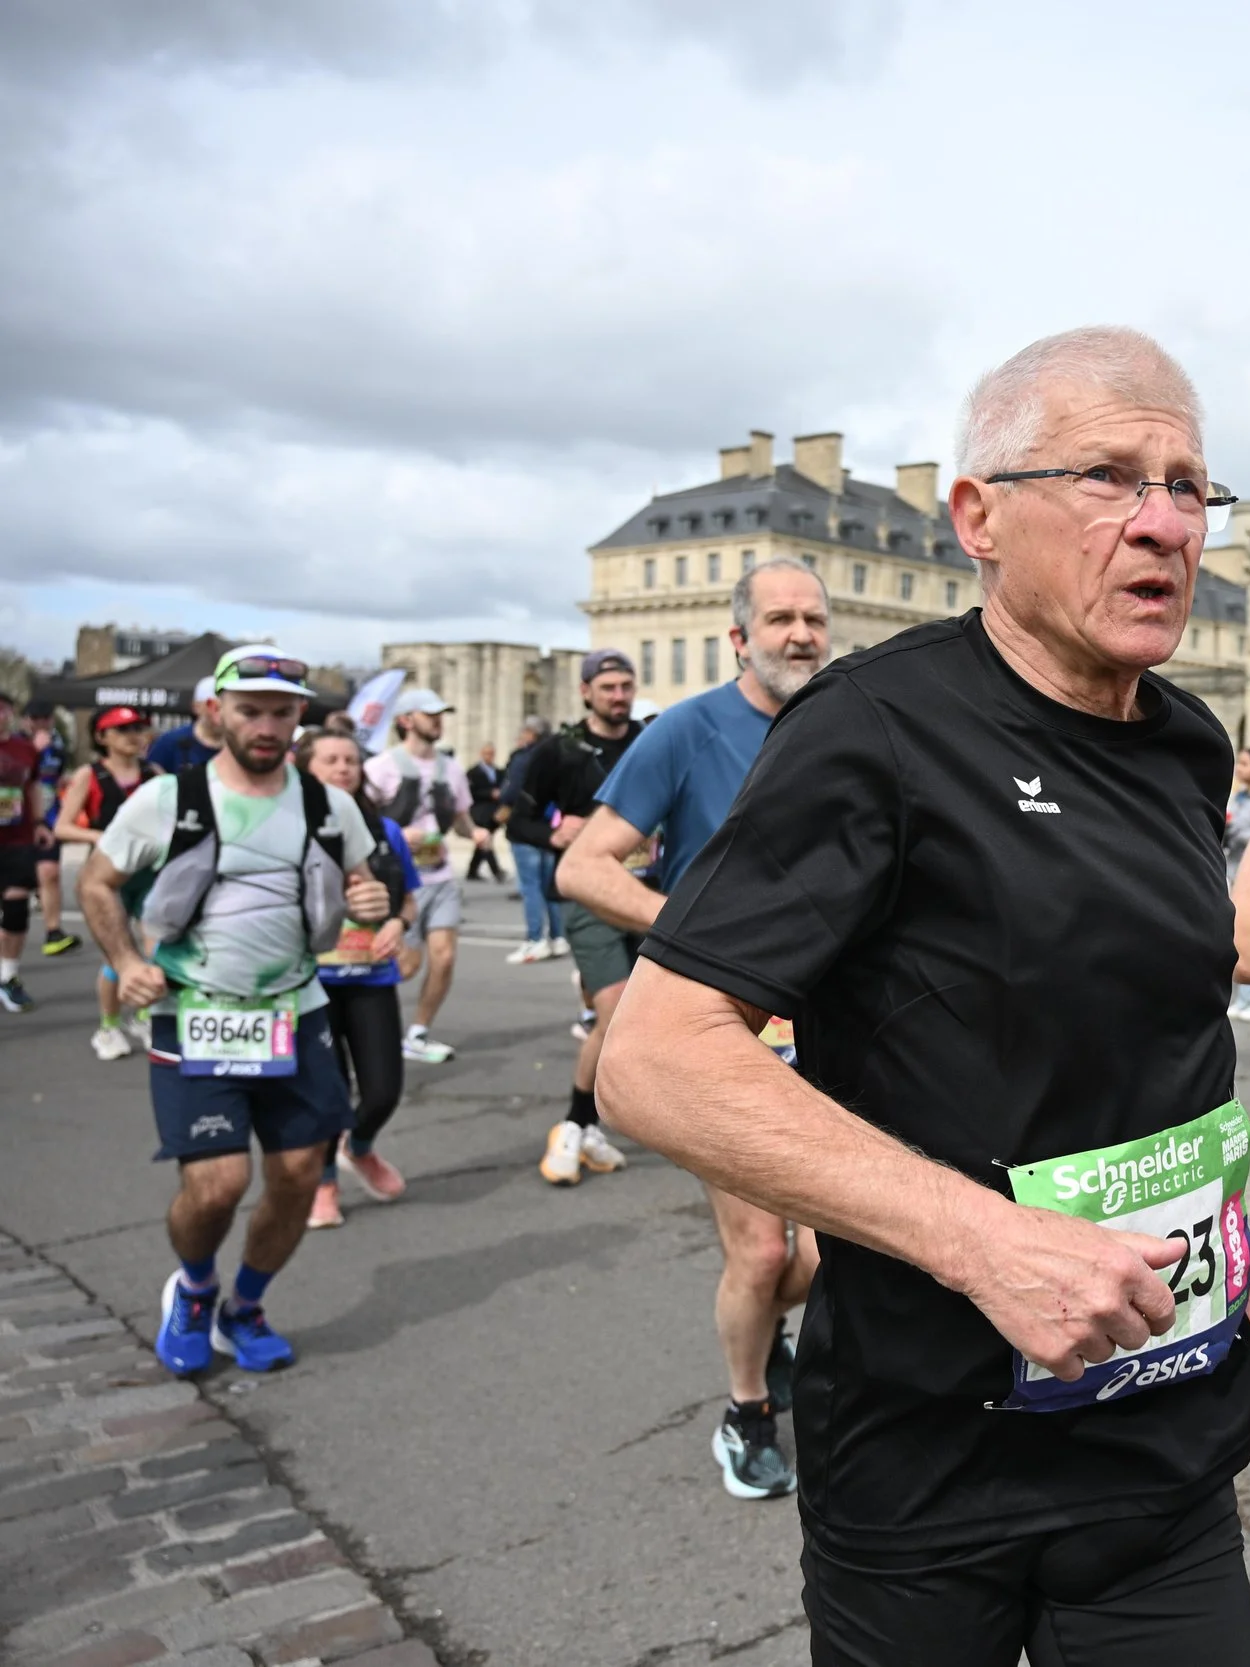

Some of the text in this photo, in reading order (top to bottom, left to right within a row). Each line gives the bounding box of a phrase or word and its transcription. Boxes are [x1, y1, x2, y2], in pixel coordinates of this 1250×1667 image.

[189, 1016, 266, 1043] 69646
[1052, 1135, 1204, 1200] Schneider
[1131, 1165, 1205, 1203] Electric
[1165, 1215, 1216, 1306] 23
[1136, 1342, 1209, 1386] asics
